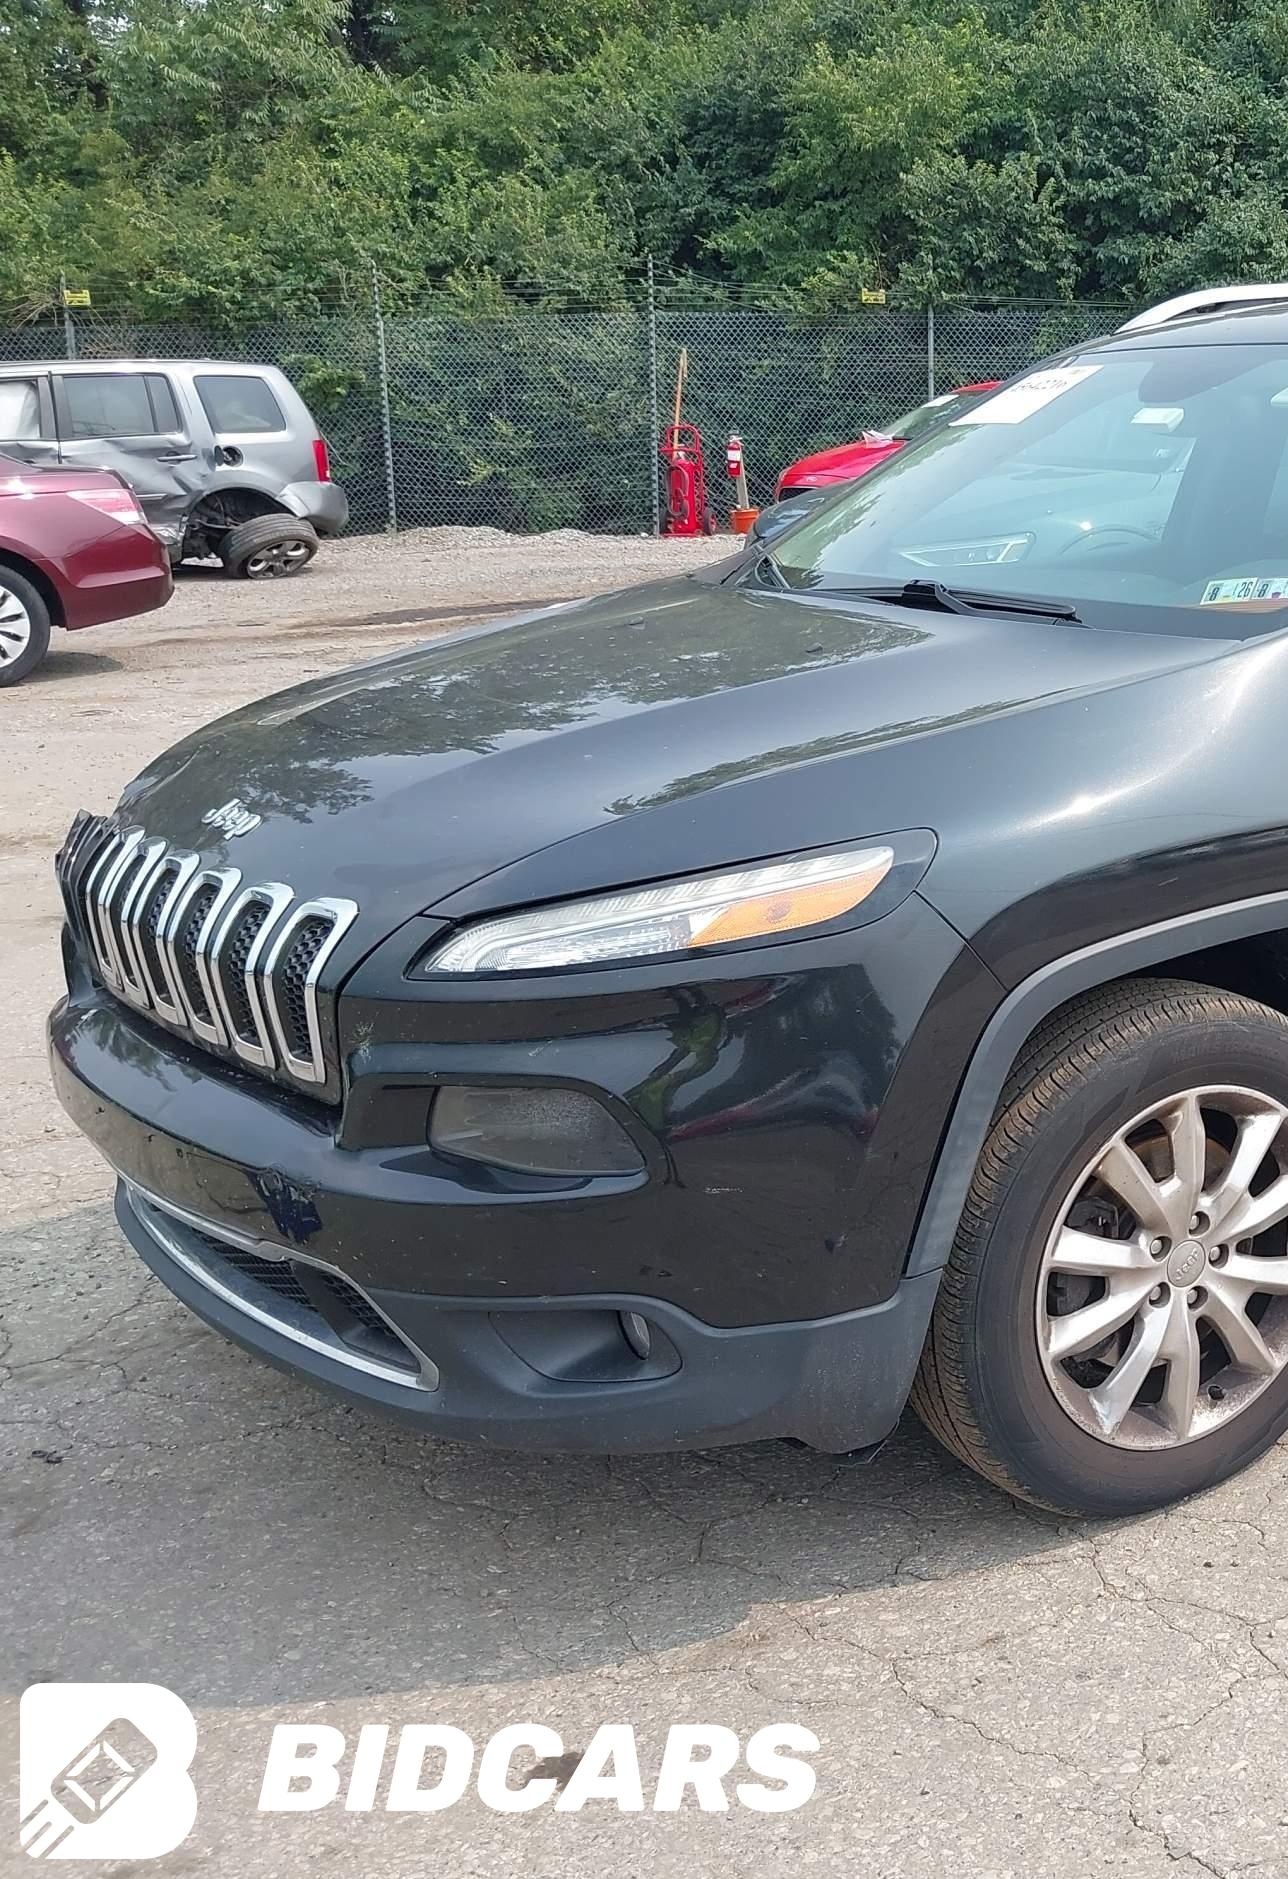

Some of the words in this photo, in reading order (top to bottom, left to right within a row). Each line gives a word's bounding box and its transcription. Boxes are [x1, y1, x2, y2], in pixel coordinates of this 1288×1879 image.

[1237, 581, 1253, 598] 26
[201, 798, 261, 840] Jeep
[1175, 1247, 1200, 1281] Jeep
